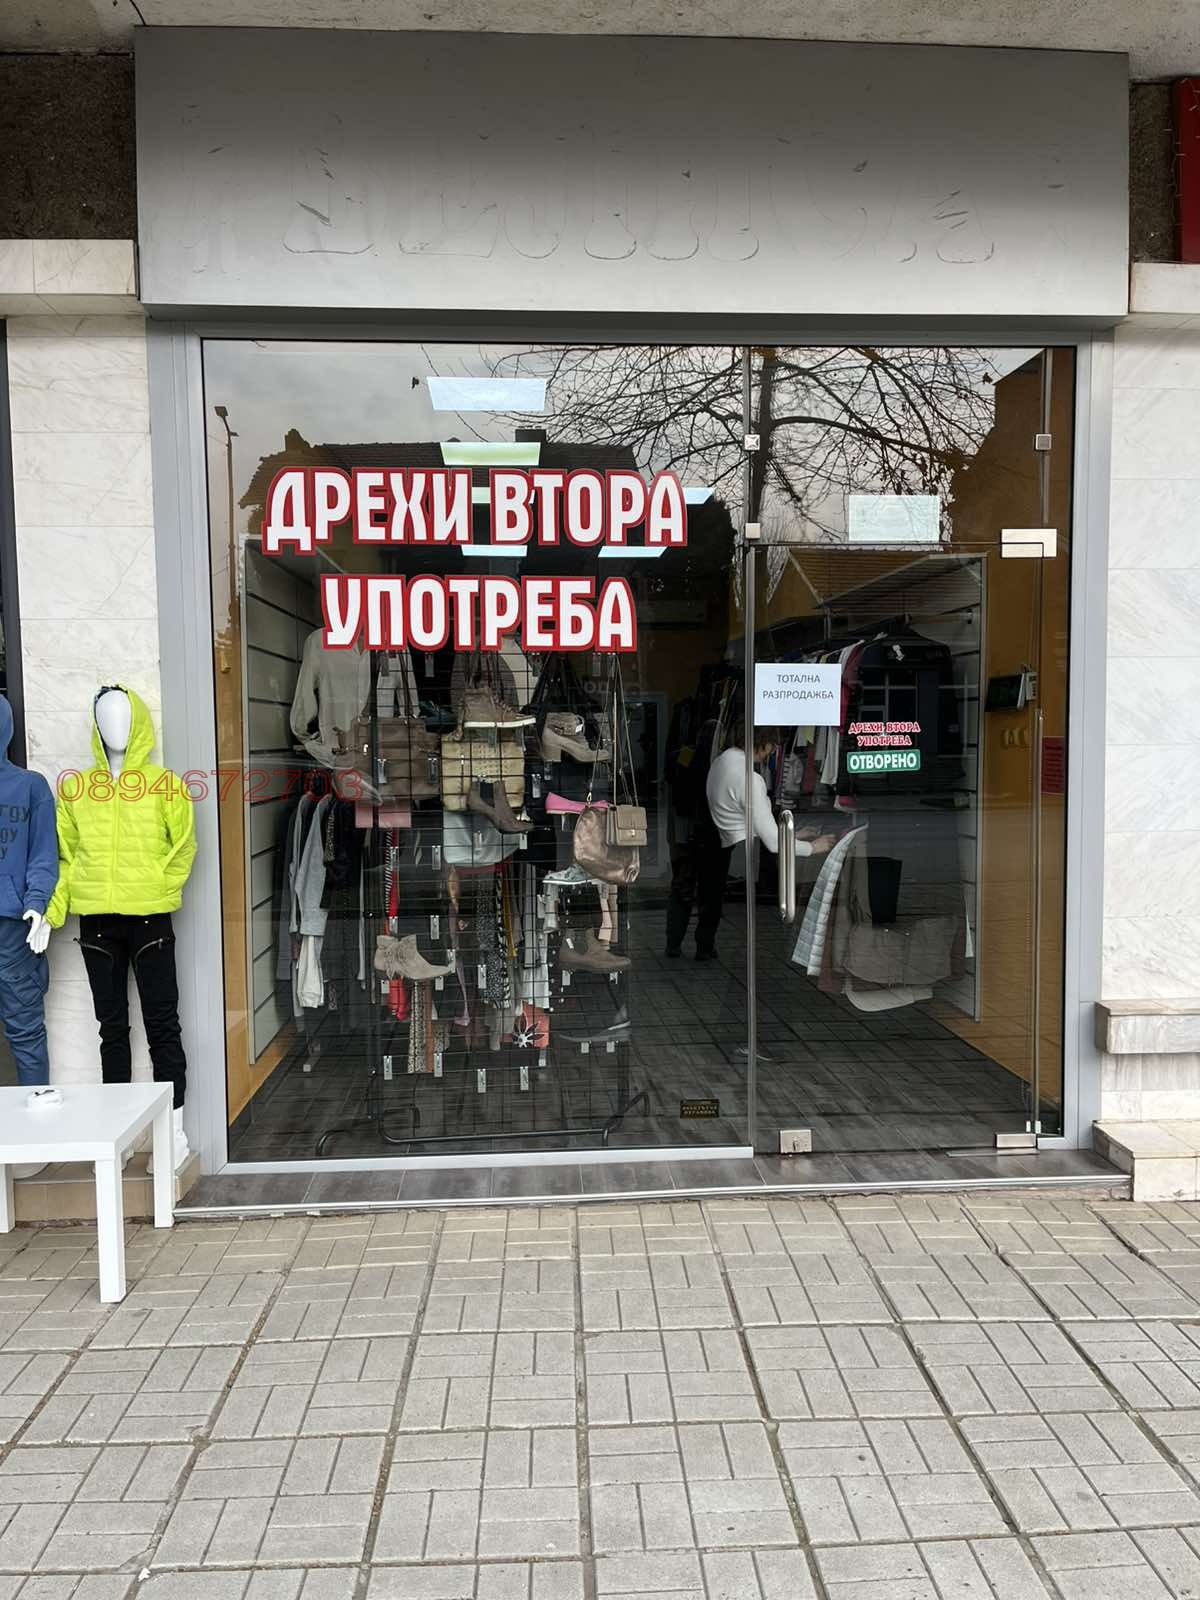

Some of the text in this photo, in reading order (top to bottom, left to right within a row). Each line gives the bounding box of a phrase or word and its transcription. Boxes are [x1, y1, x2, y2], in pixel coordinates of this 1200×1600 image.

[262, 467, 688, 555] ДРЕХИ ВТОРА
[321, 574, 637, 652] УПОТРЕБА
[776, 673, 821, 684] ТОТАЛНА
[762, 689, 835, 701] РАЗПРОДАЖБА
[848, 721, 921, 734] ДРЕХИ ВТОРА
[857, 734, 913, 746] УПОТРЕБА
[849, 752, 917, 770] ОТВОРЕНО
